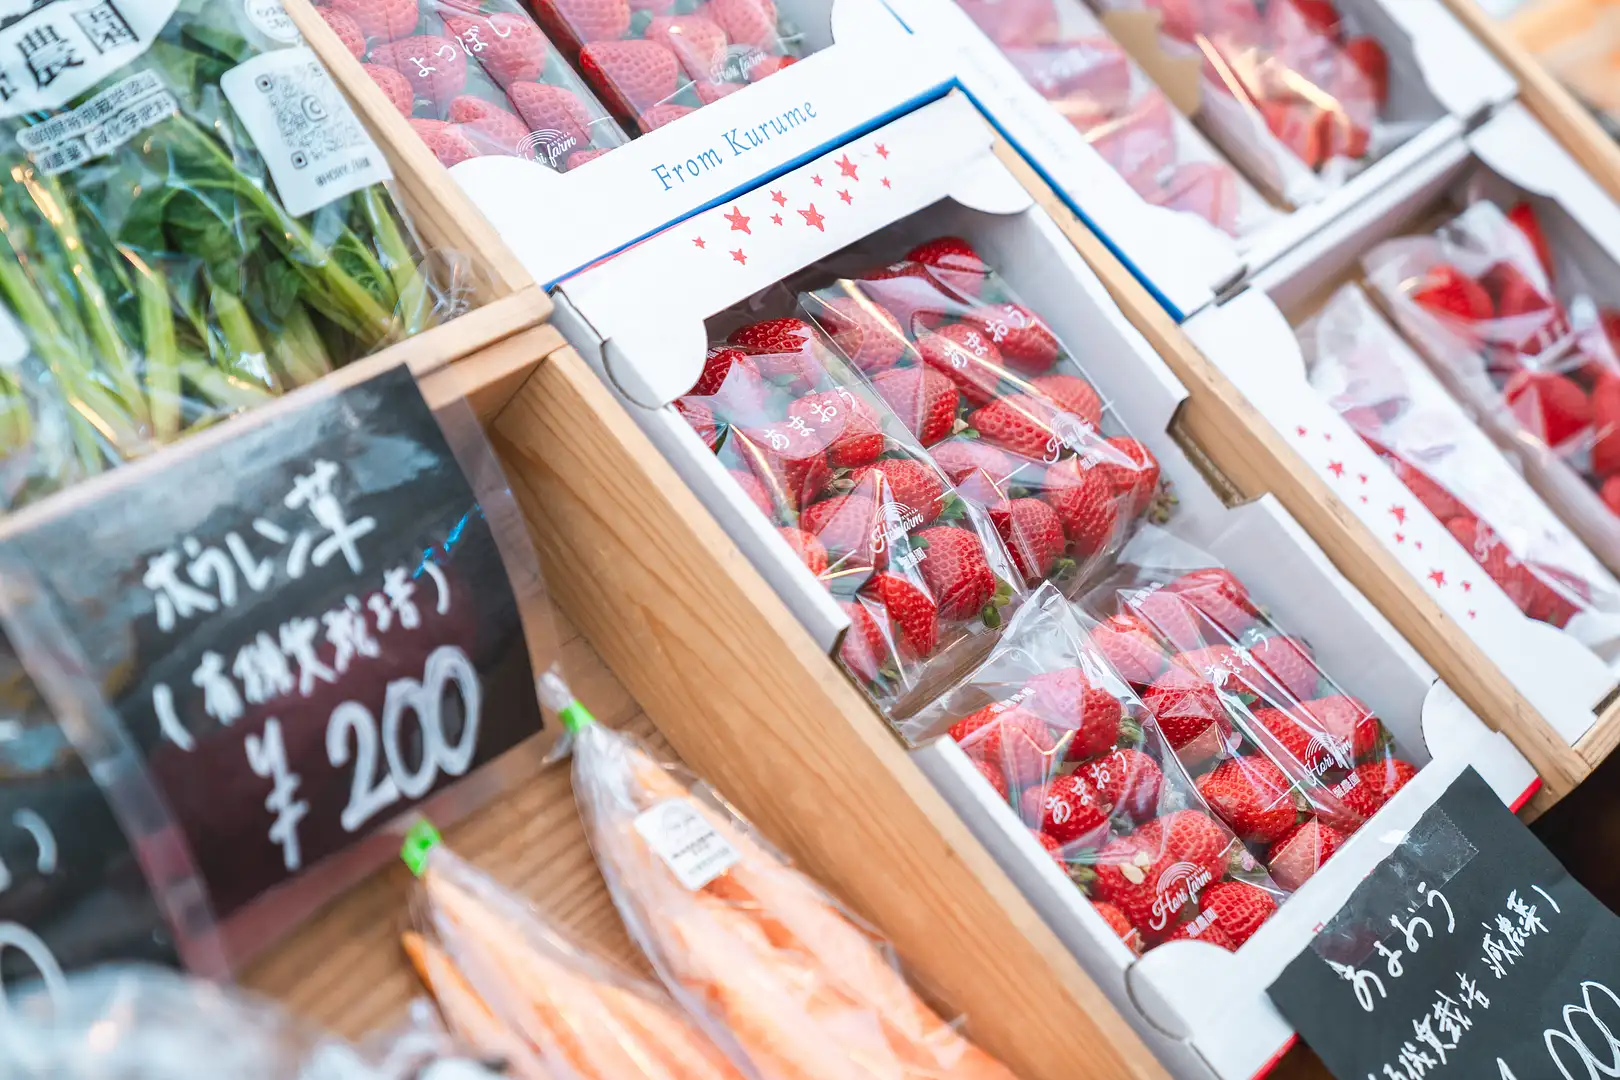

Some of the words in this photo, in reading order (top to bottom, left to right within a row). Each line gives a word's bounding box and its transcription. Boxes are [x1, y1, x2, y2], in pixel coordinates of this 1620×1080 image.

[546, 136, 577, 168] farm
[651, 148, 723, 191] From
[721, 101, 817, 156] Kurume
[943, 305, 1026, 369] あまおう
[763, 385, 856, 450] あまおう
[1045, 744, 1127, 825] あまおう
[1303, 753, 1335, 787] Hori
[1148, 888, 1188, 931] Hori
[1185, 870, 1213, 905] farm
[1324, 881, 1455, 1012] あまおう
